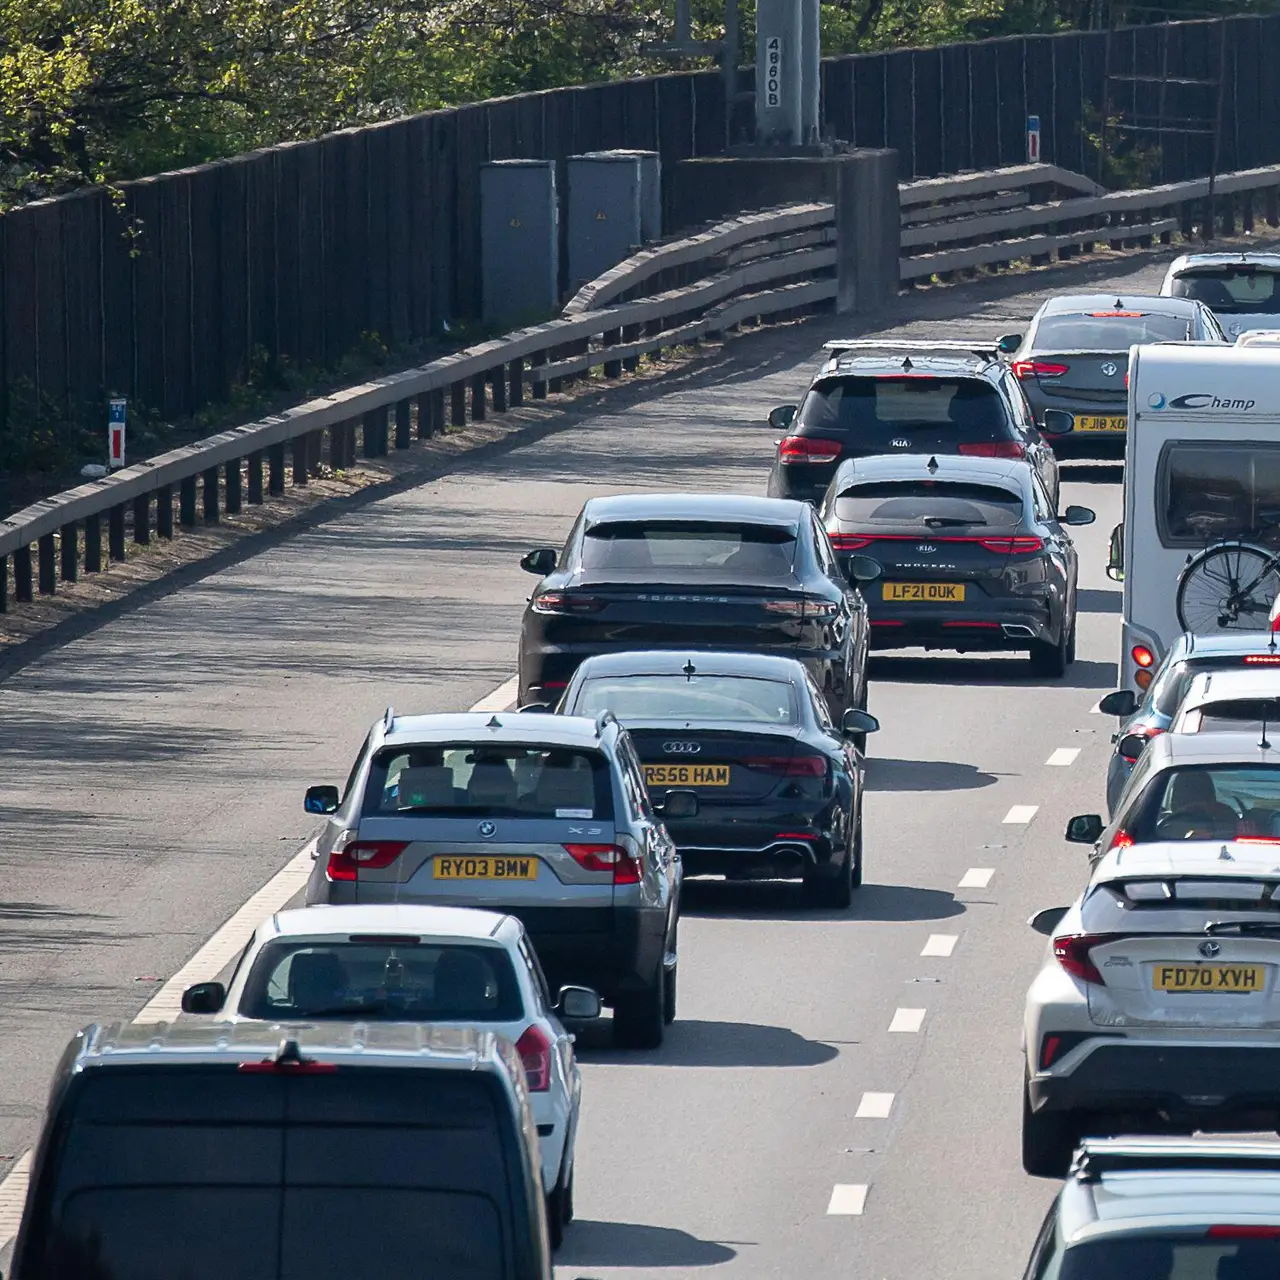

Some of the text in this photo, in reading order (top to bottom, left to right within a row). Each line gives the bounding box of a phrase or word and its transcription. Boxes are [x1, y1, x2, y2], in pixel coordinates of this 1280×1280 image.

[1168, 394, 1255, 412] Champ
[1109, 418, 1129, 430] XO
[892, 584, 956, 599] LF21 OUK
[645, 766, 727, 783] RS56 HAM
[439, 859, 531, 877] RY03 BMW
[1161, 968, 1256, 988] FD70 XVH
